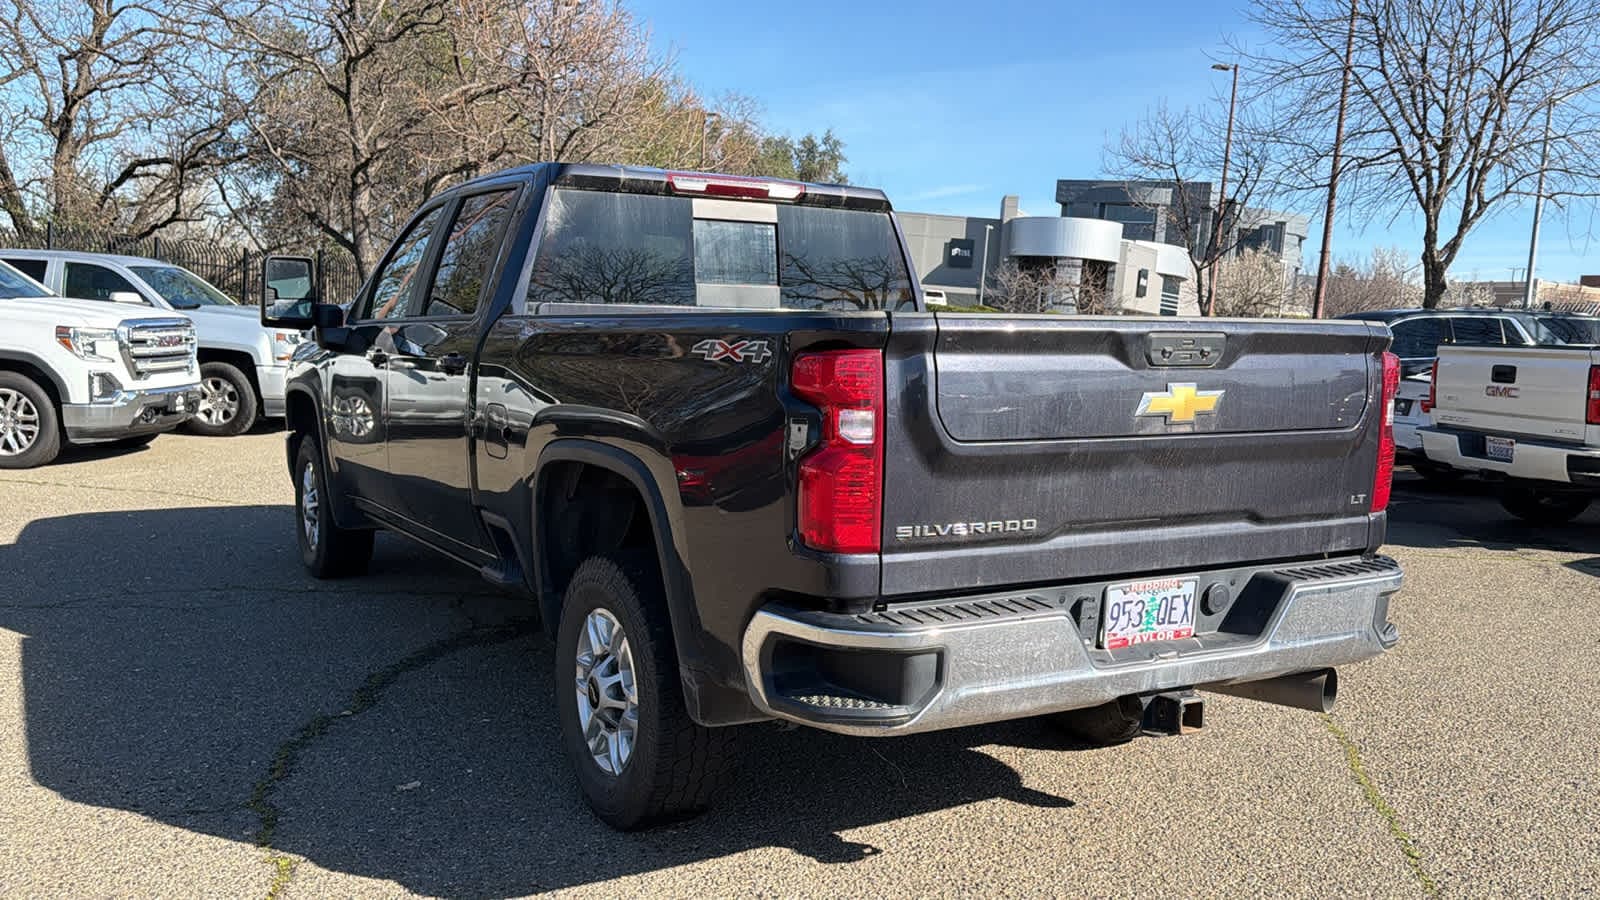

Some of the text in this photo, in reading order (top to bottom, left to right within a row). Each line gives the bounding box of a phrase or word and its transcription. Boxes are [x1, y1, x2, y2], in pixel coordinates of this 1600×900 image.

[1486, 385, 1520, 398] GMC
[1350, 494, 1367, 504] LT
[896, 519, 1037, 538] SILVERADO
[1108, 593, 1192, 632] 953 QEX
[1128, 630, 1174, 646] TAYLOR
